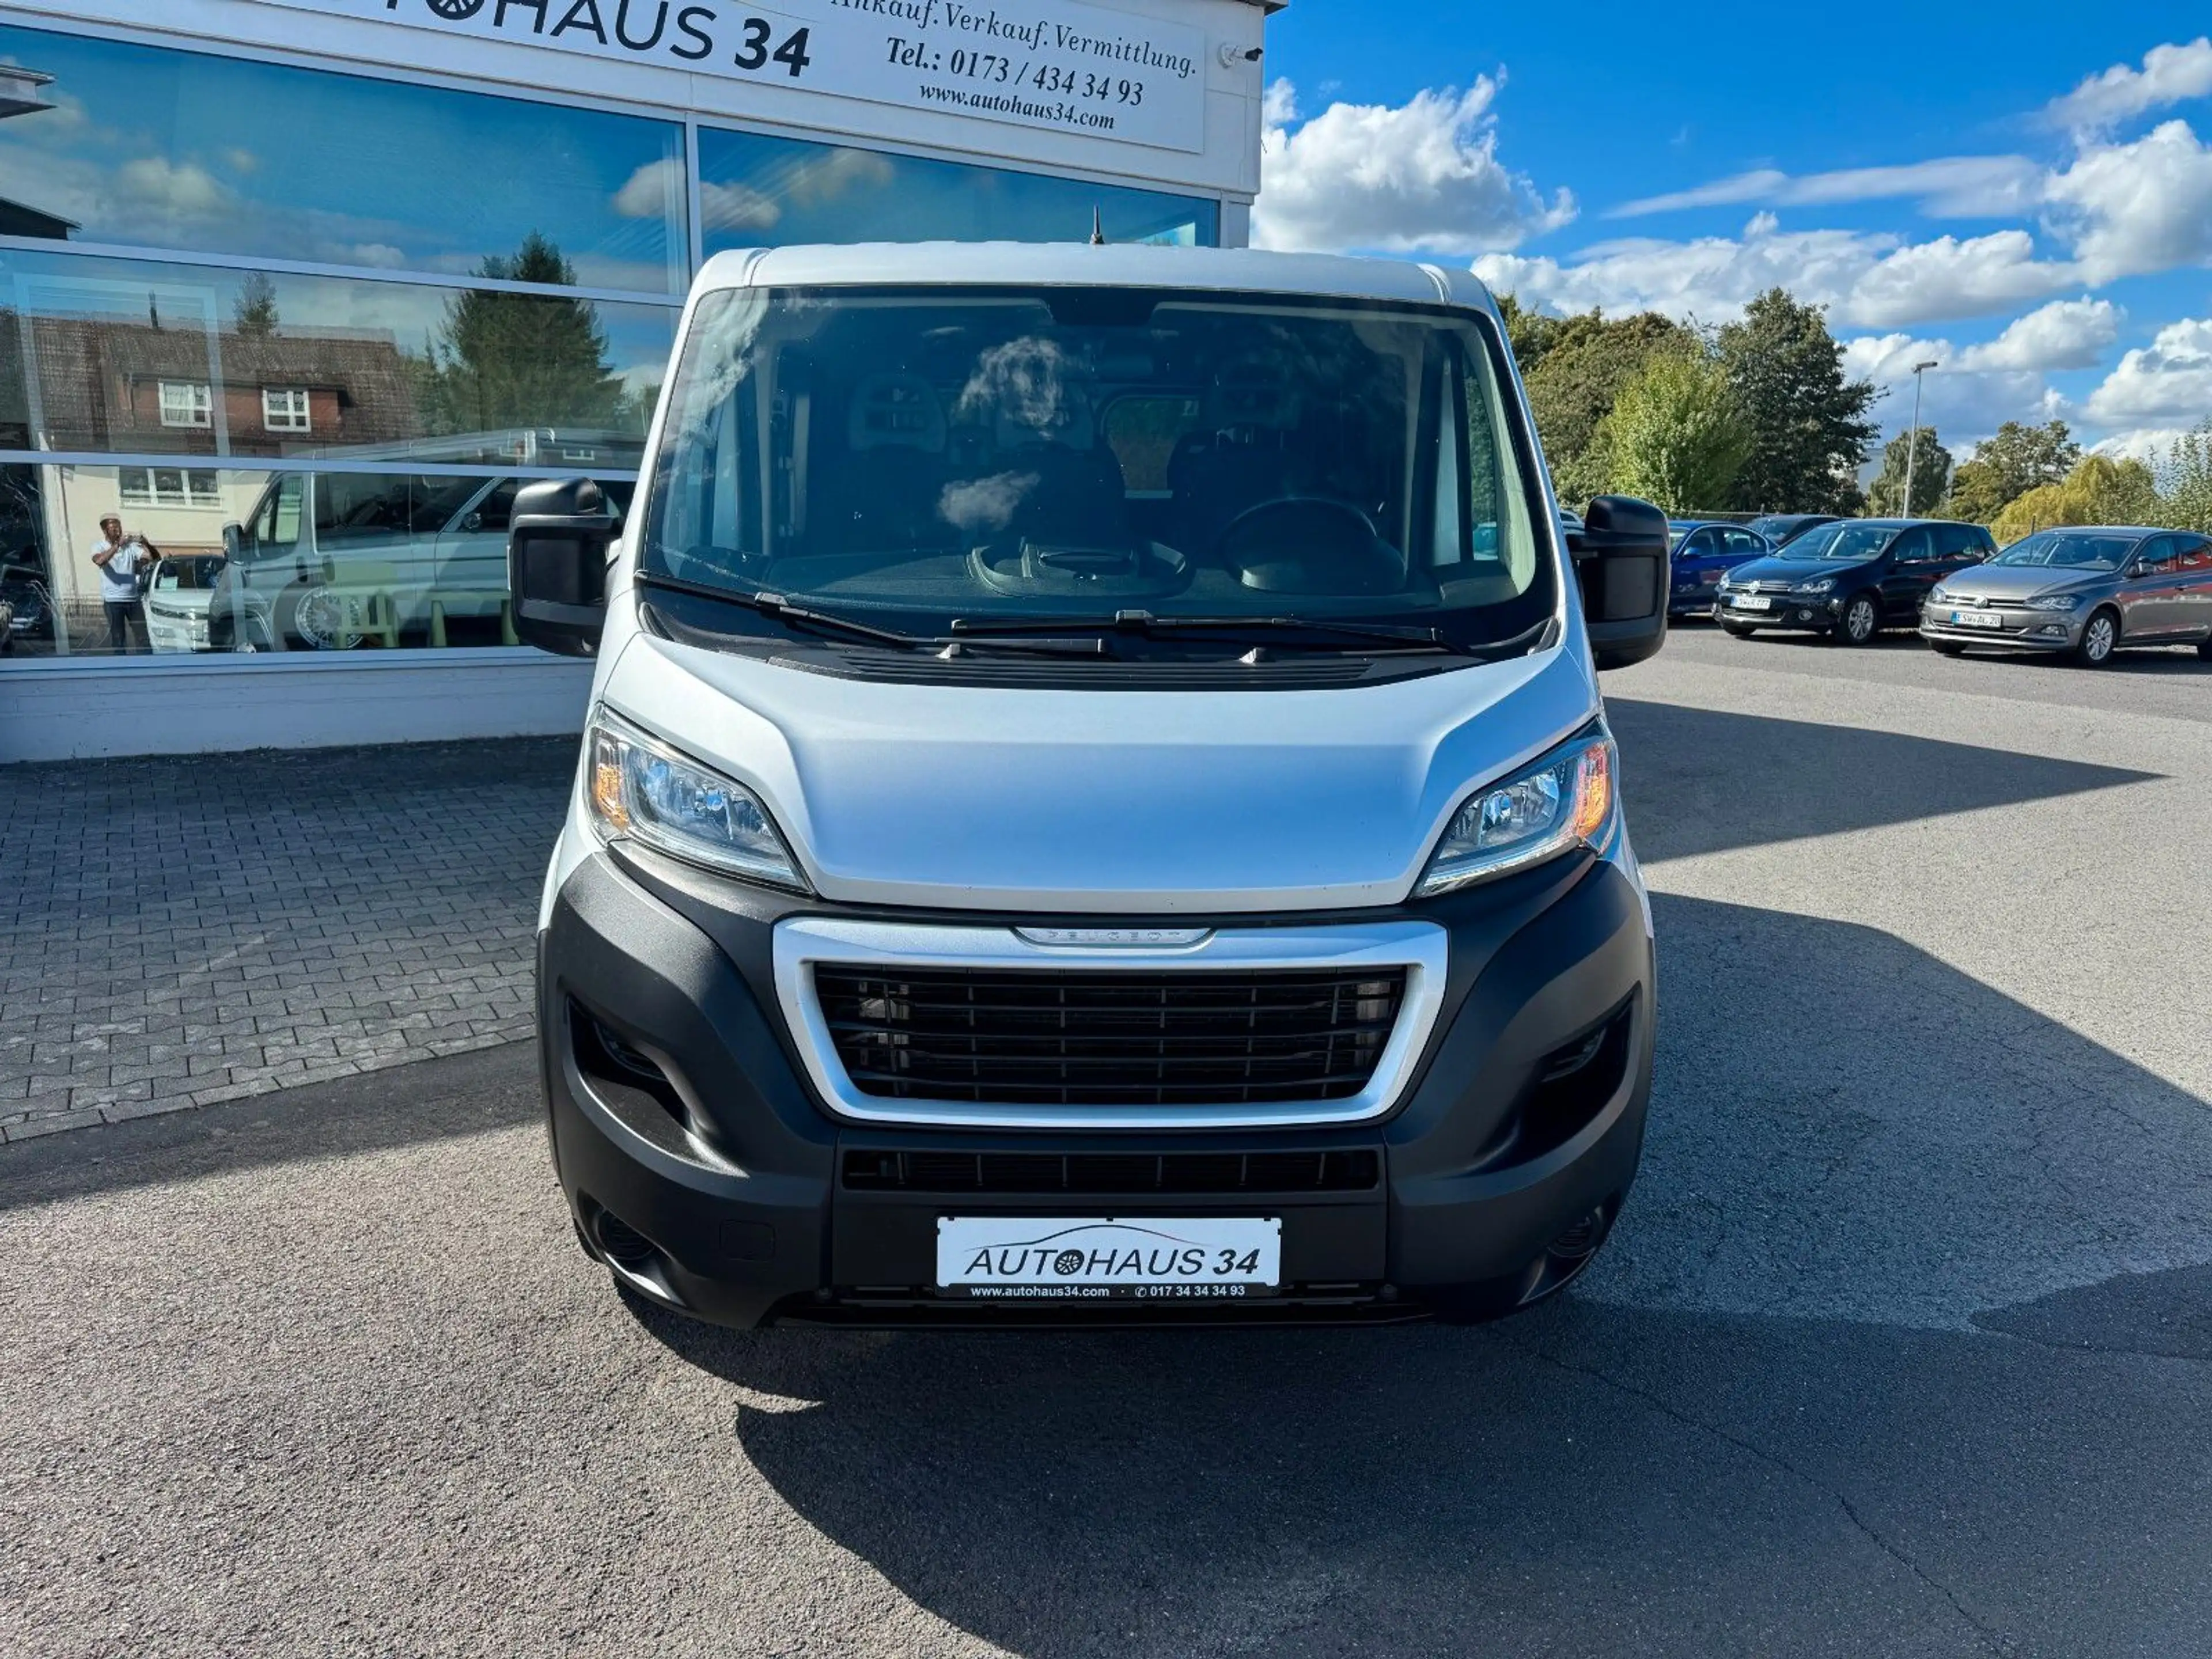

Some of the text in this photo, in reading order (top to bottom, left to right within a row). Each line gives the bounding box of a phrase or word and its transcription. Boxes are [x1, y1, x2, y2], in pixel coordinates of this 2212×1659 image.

[733, 17, 811, 78] 34
[887, 37, 1144, 106] Tel.: 0173 / 434 34 93
[919, 84, 1115, 130] www.autohaus34.com
[1048, 929, 1184, 942] PEGEOT
[964, 1248, 1260, 1276] AUTOHAUS 34
[971, 1286, 1245, 1297] www.autohaus34.com 017 34 34 34 93
